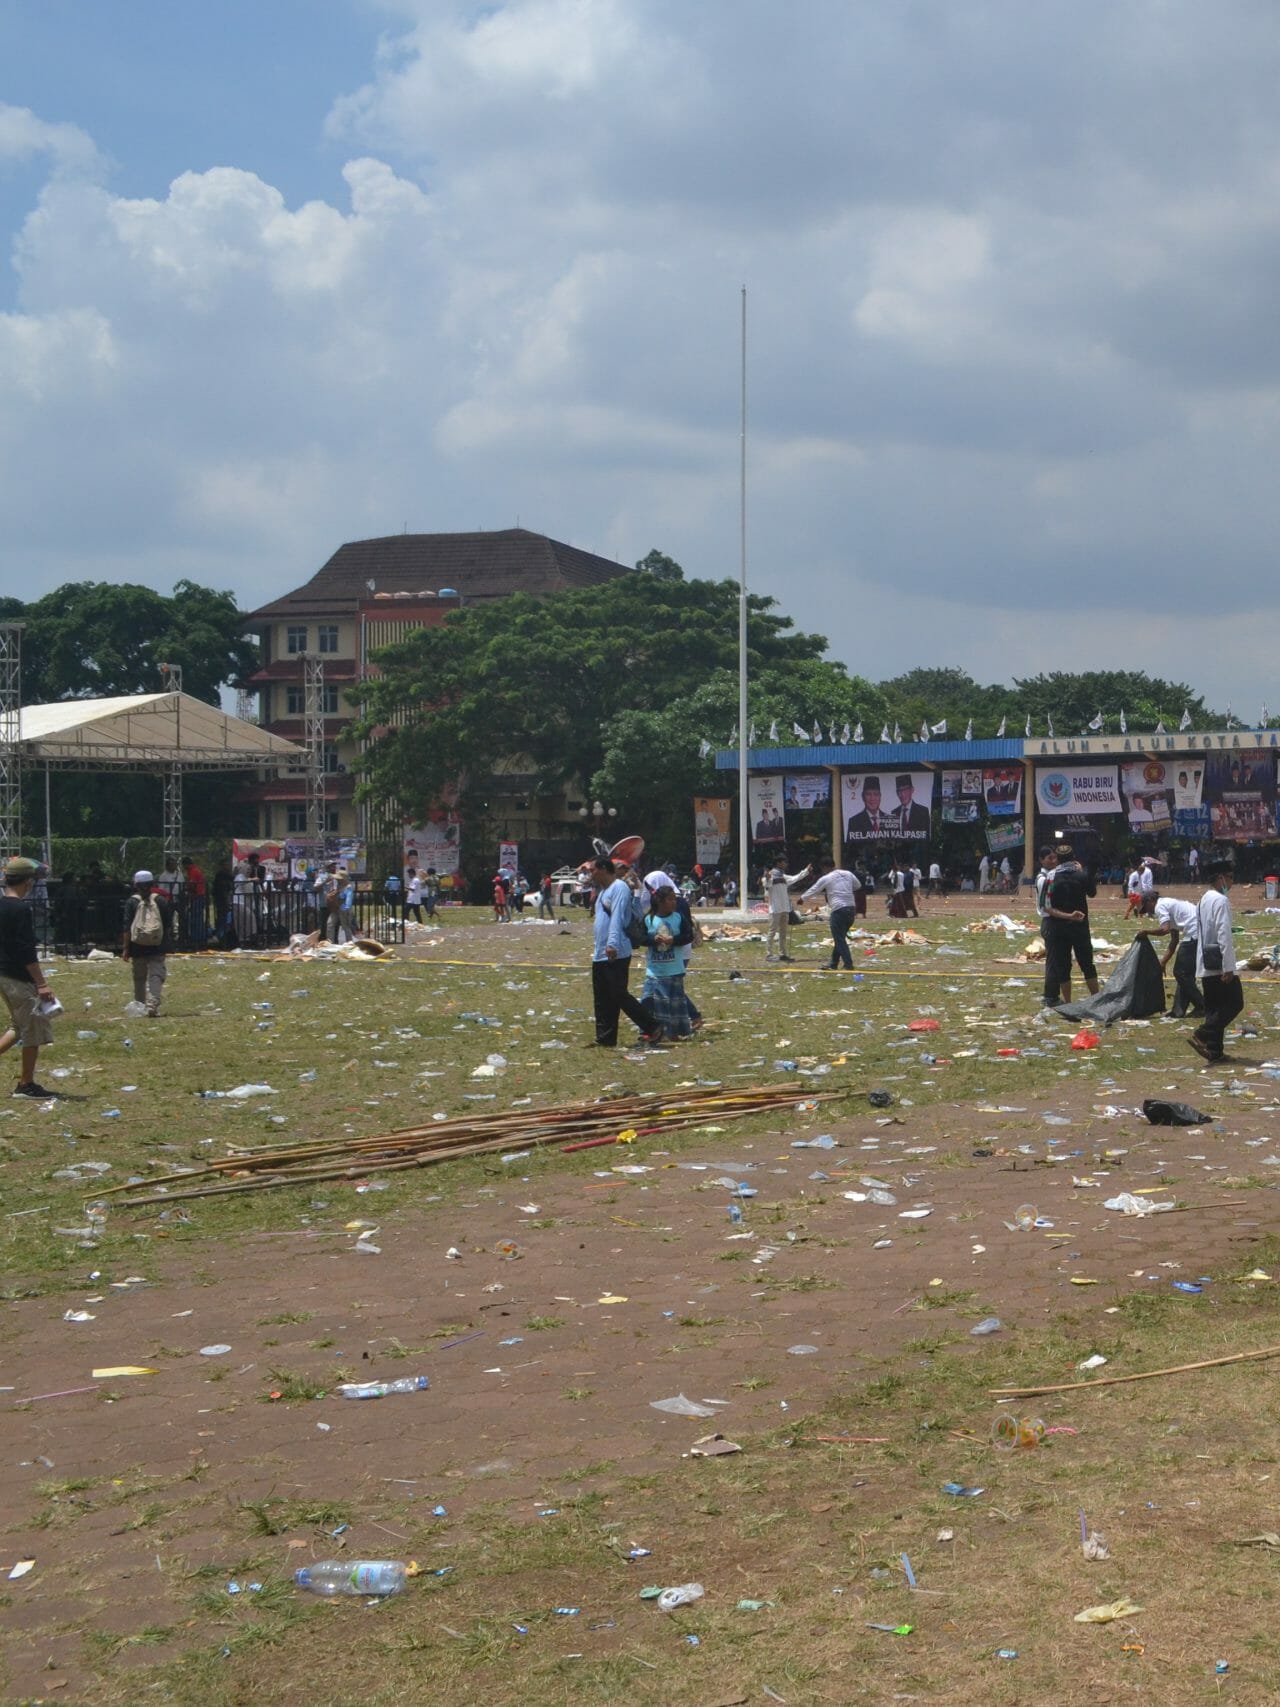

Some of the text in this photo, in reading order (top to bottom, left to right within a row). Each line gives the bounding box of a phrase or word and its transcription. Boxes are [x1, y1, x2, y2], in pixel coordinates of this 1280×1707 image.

[1040, 740, 1089, 754] ALUN
[1124, 737, 1175, 751] ALUN
[1188, 734, 1240, 749] KOTA
[1072, 776, 1113, 789] RABU BIRU
[850, 791, 856, 800] 2
[1073, 791, 1115, 803] INDONESIA
[849, 830, 890, 840] RELAWAN
